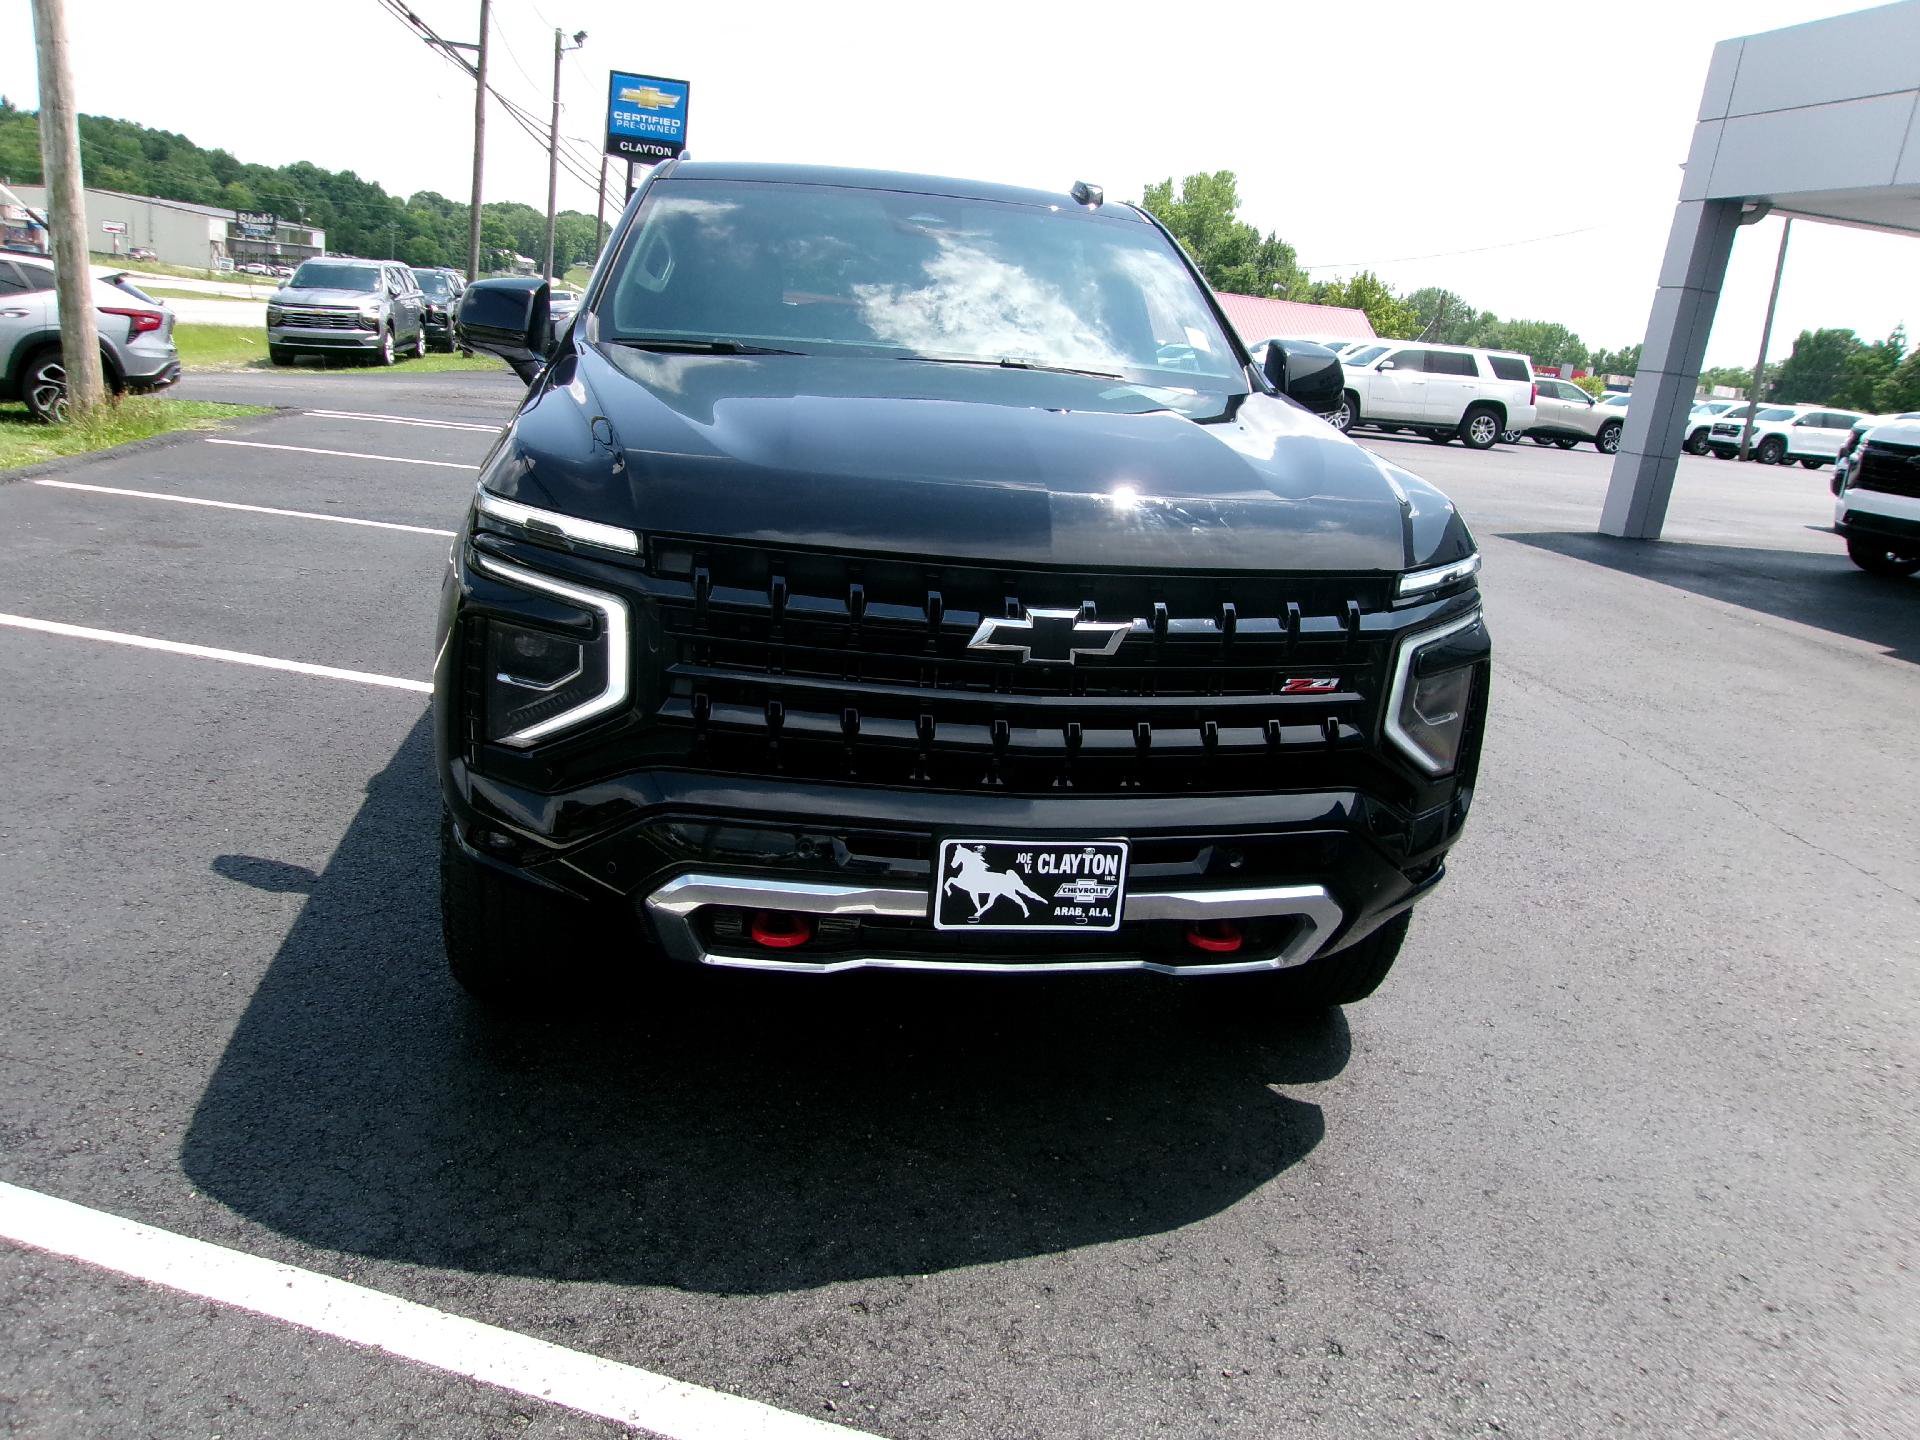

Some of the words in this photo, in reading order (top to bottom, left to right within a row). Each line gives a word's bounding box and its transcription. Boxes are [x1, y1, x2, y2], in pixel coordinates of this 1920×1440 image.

[613, 111, 681, 127] CERTIFIED
[616, 119, 677, 135] PRE-OWNED
[619, 141, 672, 157] CLAYTON
[1015, 852, 1033, 864] JOE
[1037, 853, 1119, 876] CLAYTON
[1024, 863, 1032, 874] V.
[1062, 886, 1109, 895] CHEVROLET
[1053, 906, 1086, 918] ARAB,
[1088, 907, 1112, 917] ALA.
